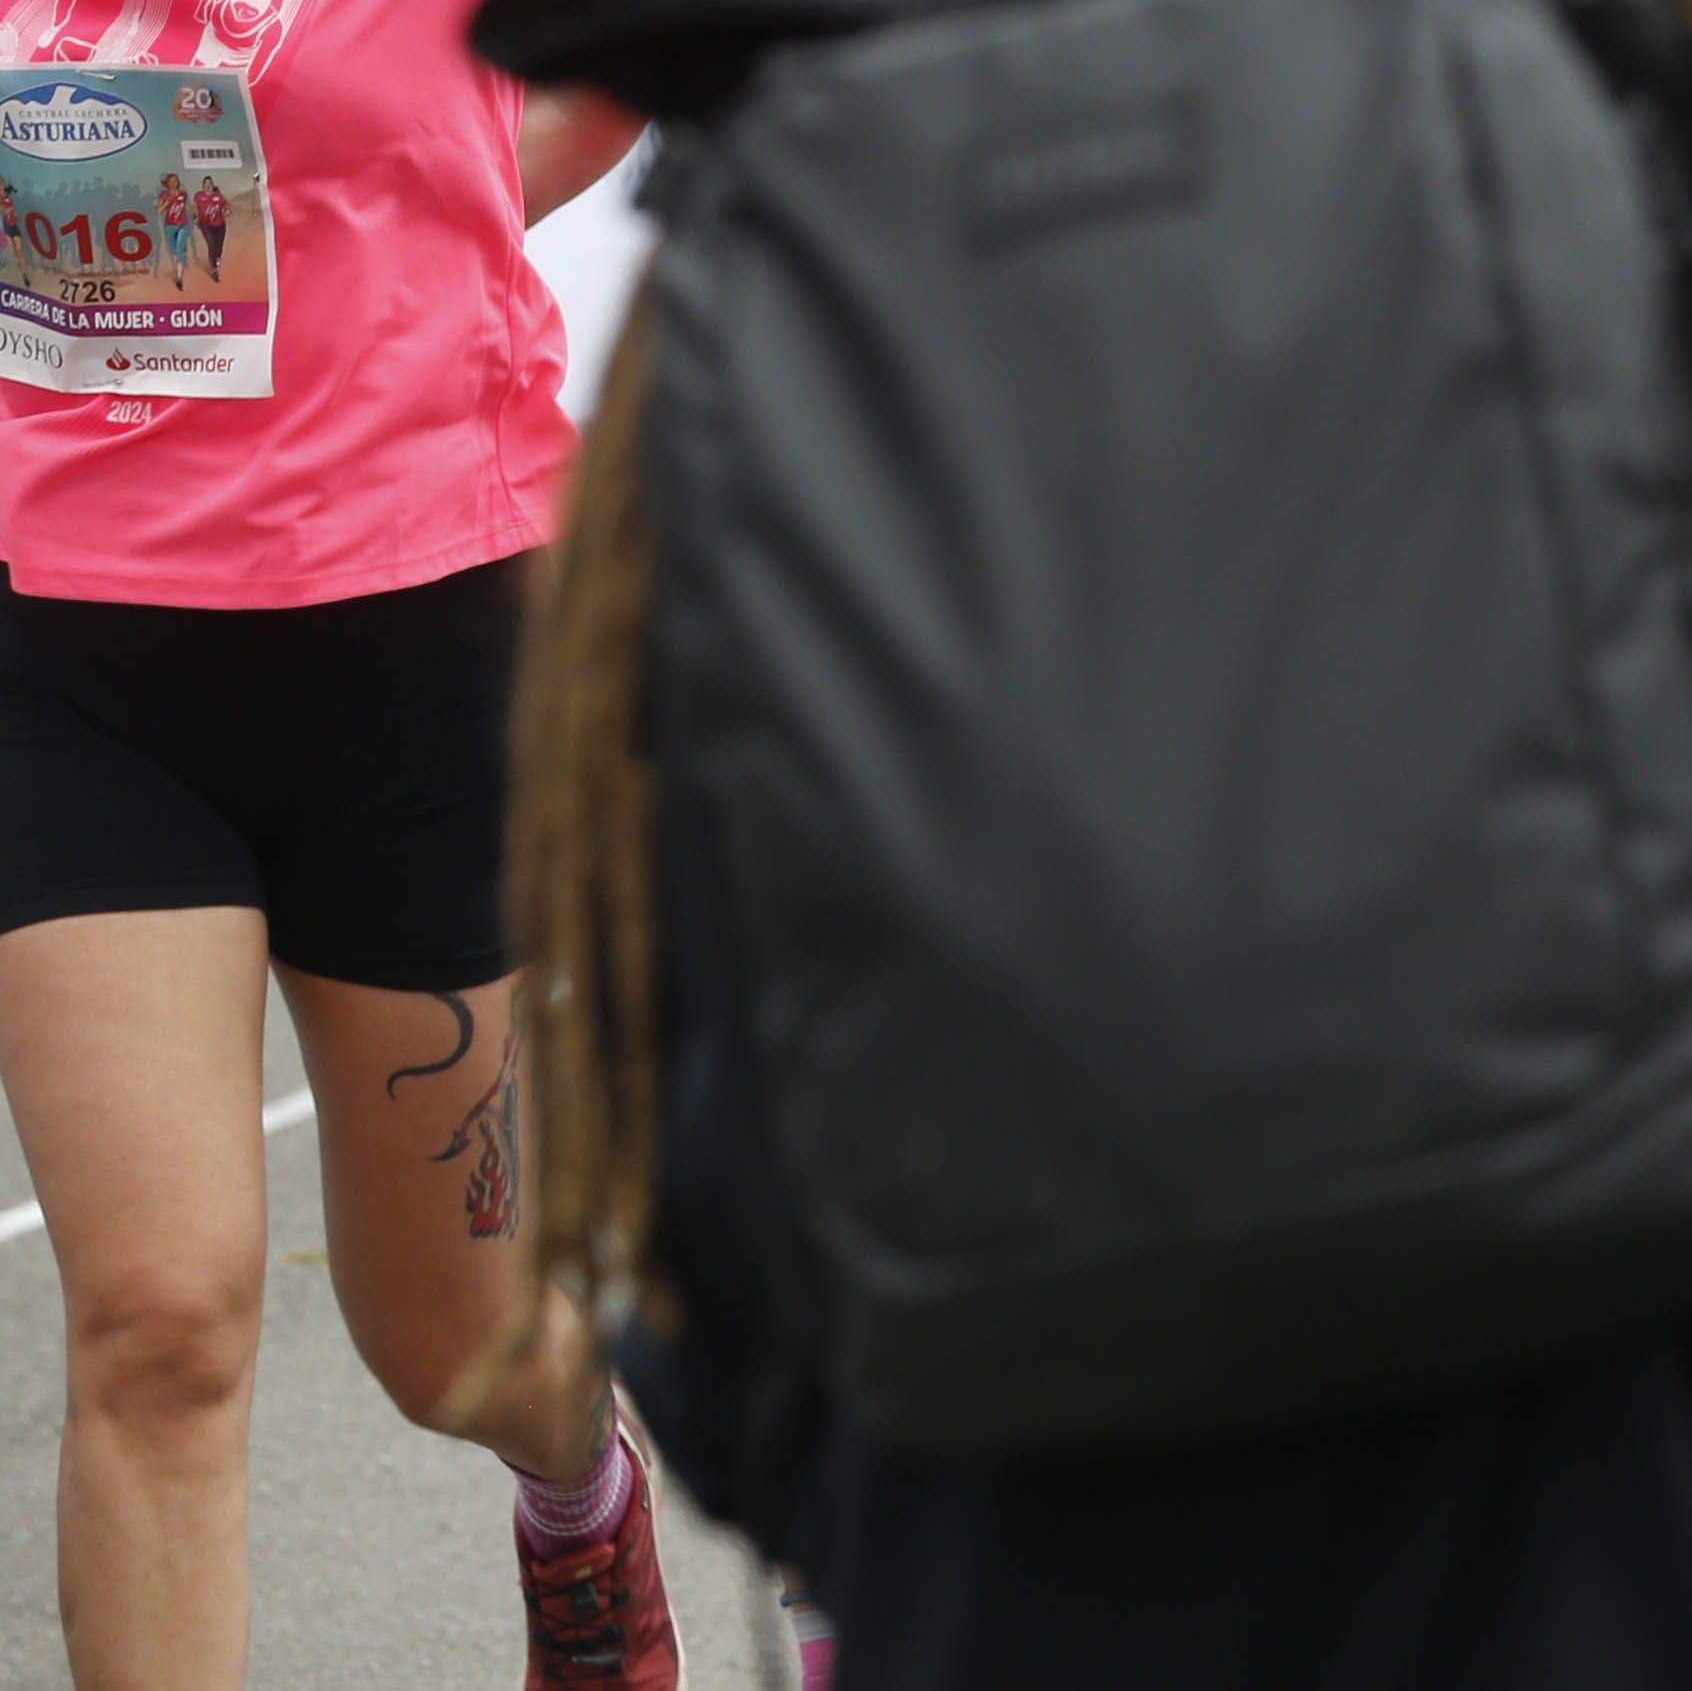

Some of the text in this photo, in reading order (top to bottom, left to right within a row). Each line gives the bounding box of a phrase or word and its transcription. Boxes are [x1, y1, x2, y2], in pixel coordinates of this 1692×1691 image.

[181, 87, 213, 109] 20
[1, 111, 135, 141] ASTURIANA
[25, 210, 152, 264] 016
[60, 278, 116, 304] 2726
[1, 289, 49, 320] CARRERA
[52, 306, 66, 326] DE
[69, 312, 90, 328] LA
[95, 311, 154, 329] MUJER
[171, 304, 222, 328] GIJÓN
[133, 353, 234, 373] Santander
[107, 401, 152, 423] 2024
